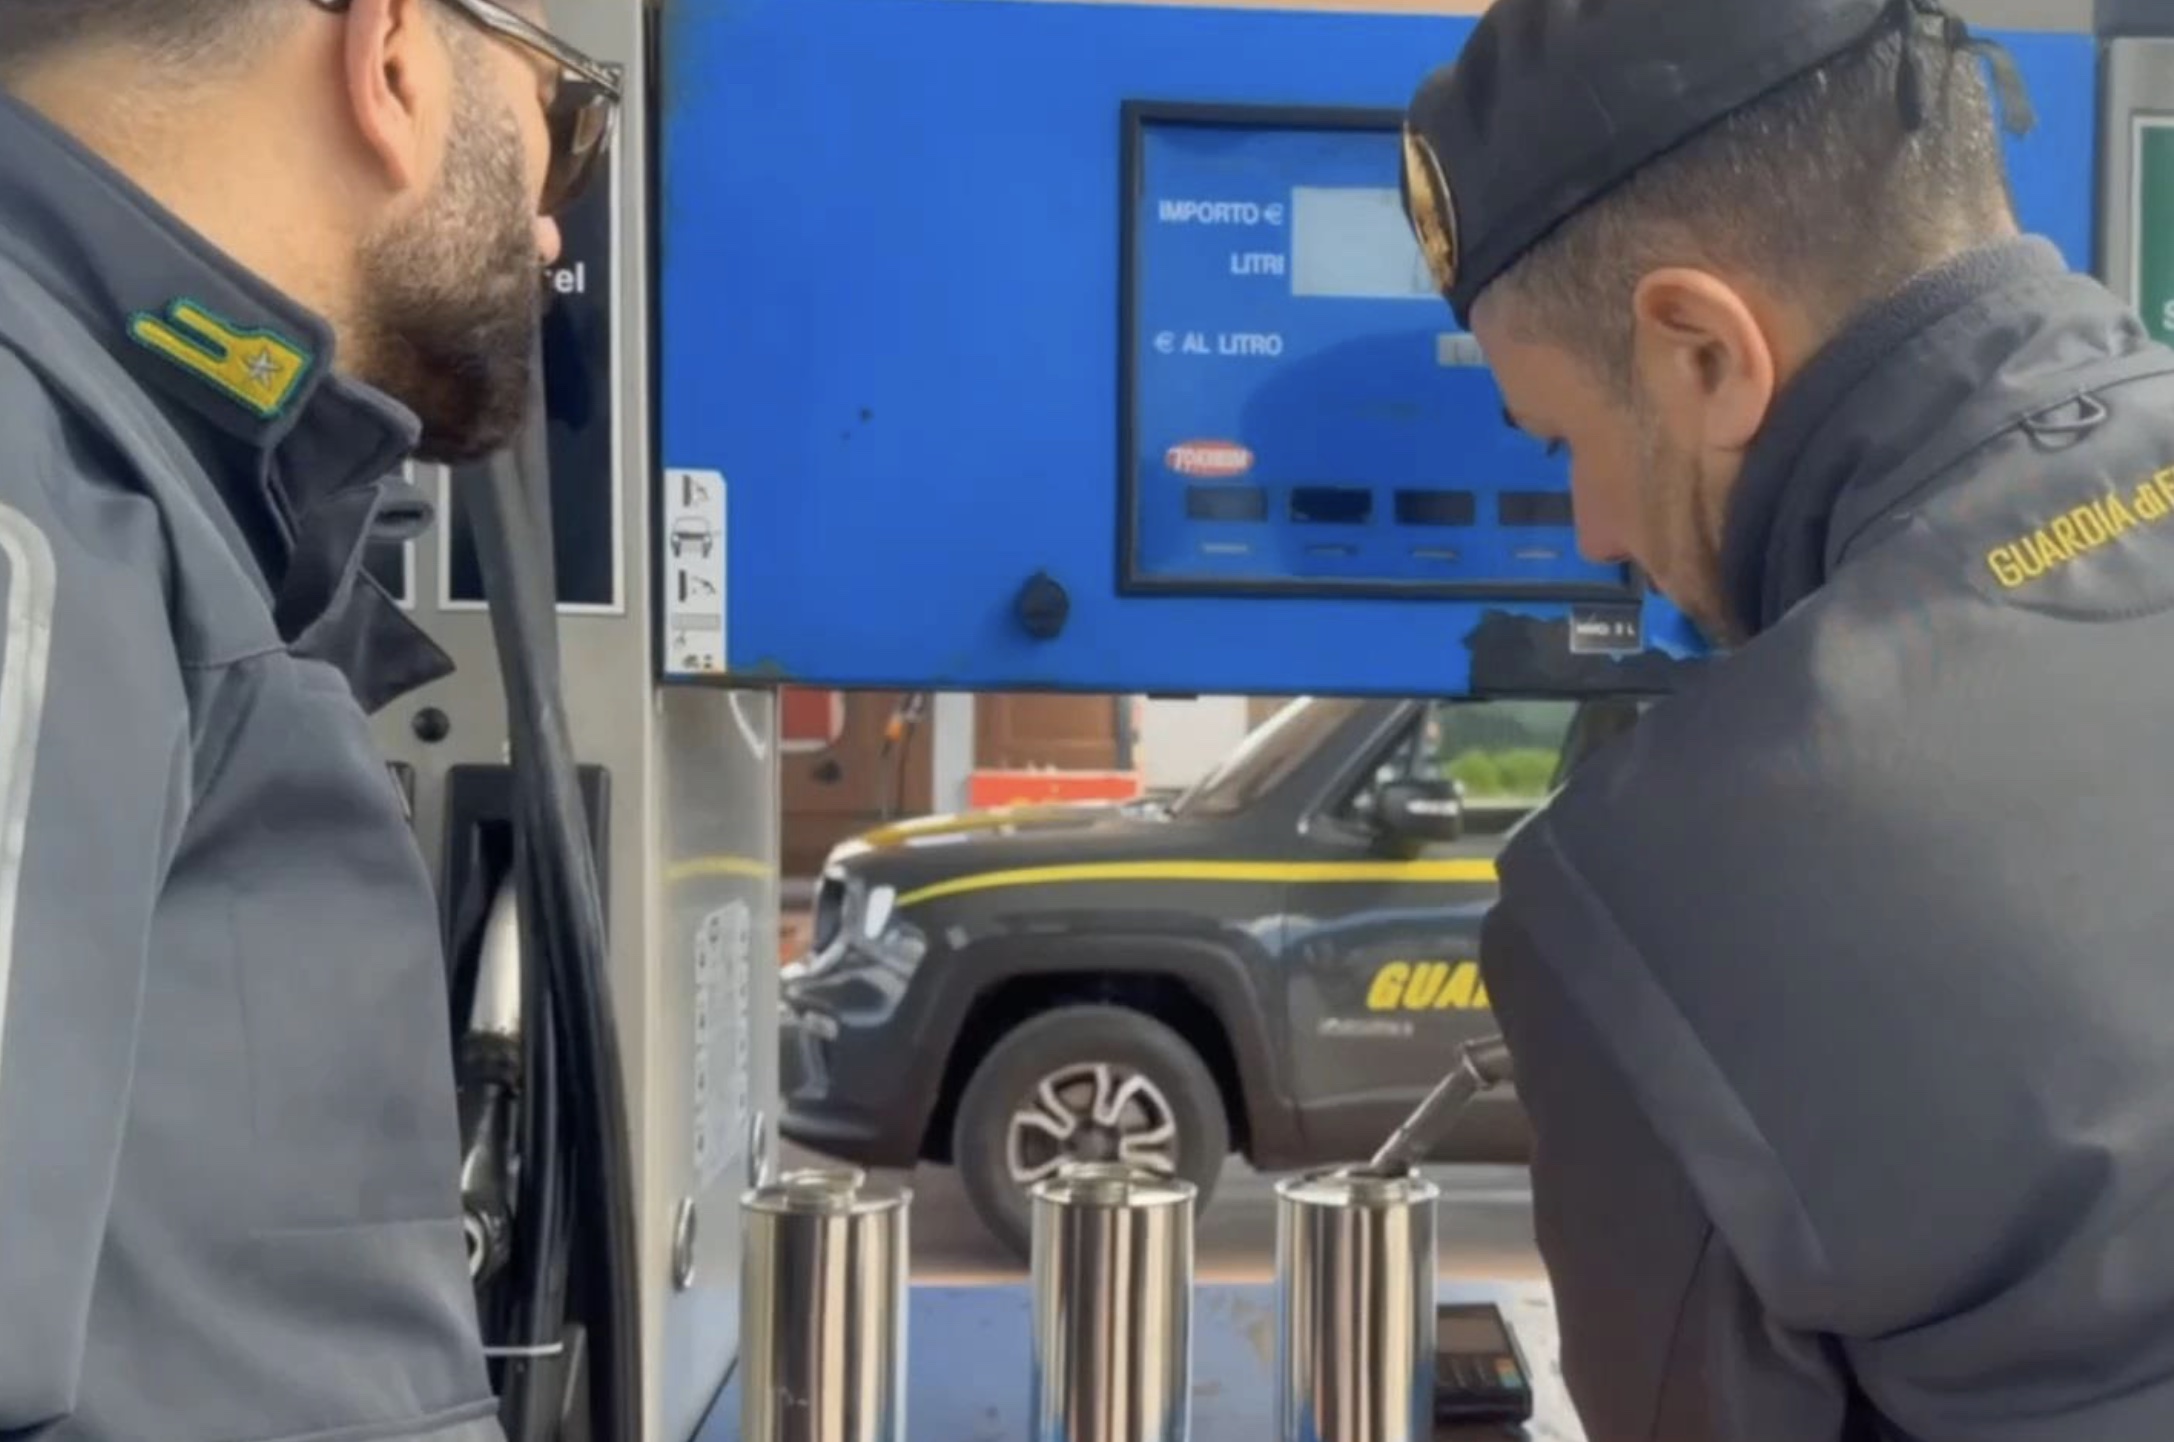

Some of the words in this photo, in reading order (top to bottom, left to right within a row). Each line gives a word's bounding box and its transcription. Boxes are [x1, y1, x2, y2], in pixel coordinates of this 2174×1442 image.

[1159, 199, 1259, 225] IMPORTO
[1230, 252, 1284, 275] LITRI
[545, 261, 585, 293] el
[1182, 332, 1210, 354] AL
[1219, 332, 1283, 356] LITRO
[1987, 492, 2138, 588] GUARDIA
